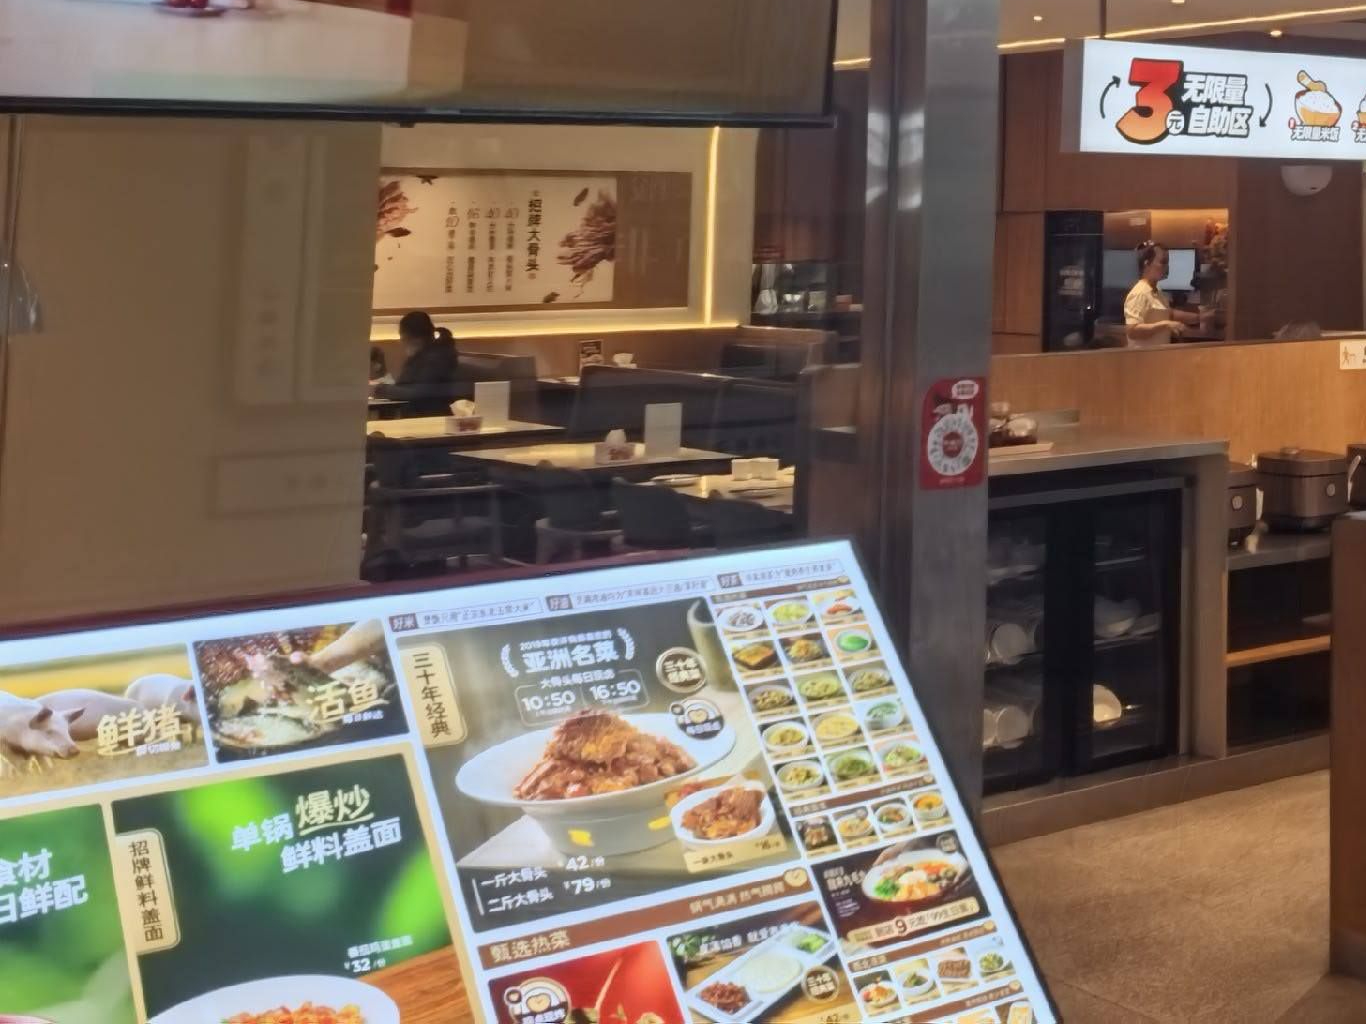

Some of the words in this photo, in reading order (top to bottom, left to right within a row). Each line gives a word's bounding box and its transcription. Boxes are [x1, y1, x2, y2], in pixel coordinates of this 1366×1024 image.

[1115, 57, 1185, 145] 3
[1181, 72, 1247, 105] 无限量
[1187, 105, 1252, 137] 自助区
[525, 198, 543, 273] 招牌大骨头
[522, 638, 619, 674] 亚洲名菜
[305, 679, 390, 721] 活鱼
[411, 651, 453, 739] 三十年经典
[521, 689, 576, 712] 10:50
[589, 679, 641, 701] 16:50
[96, 703, 182, 750] 鲜猪
[281, 816, 402, 874] 鲜料盖面
[128, 839, 164, 943] 招牌鲜料盖面
